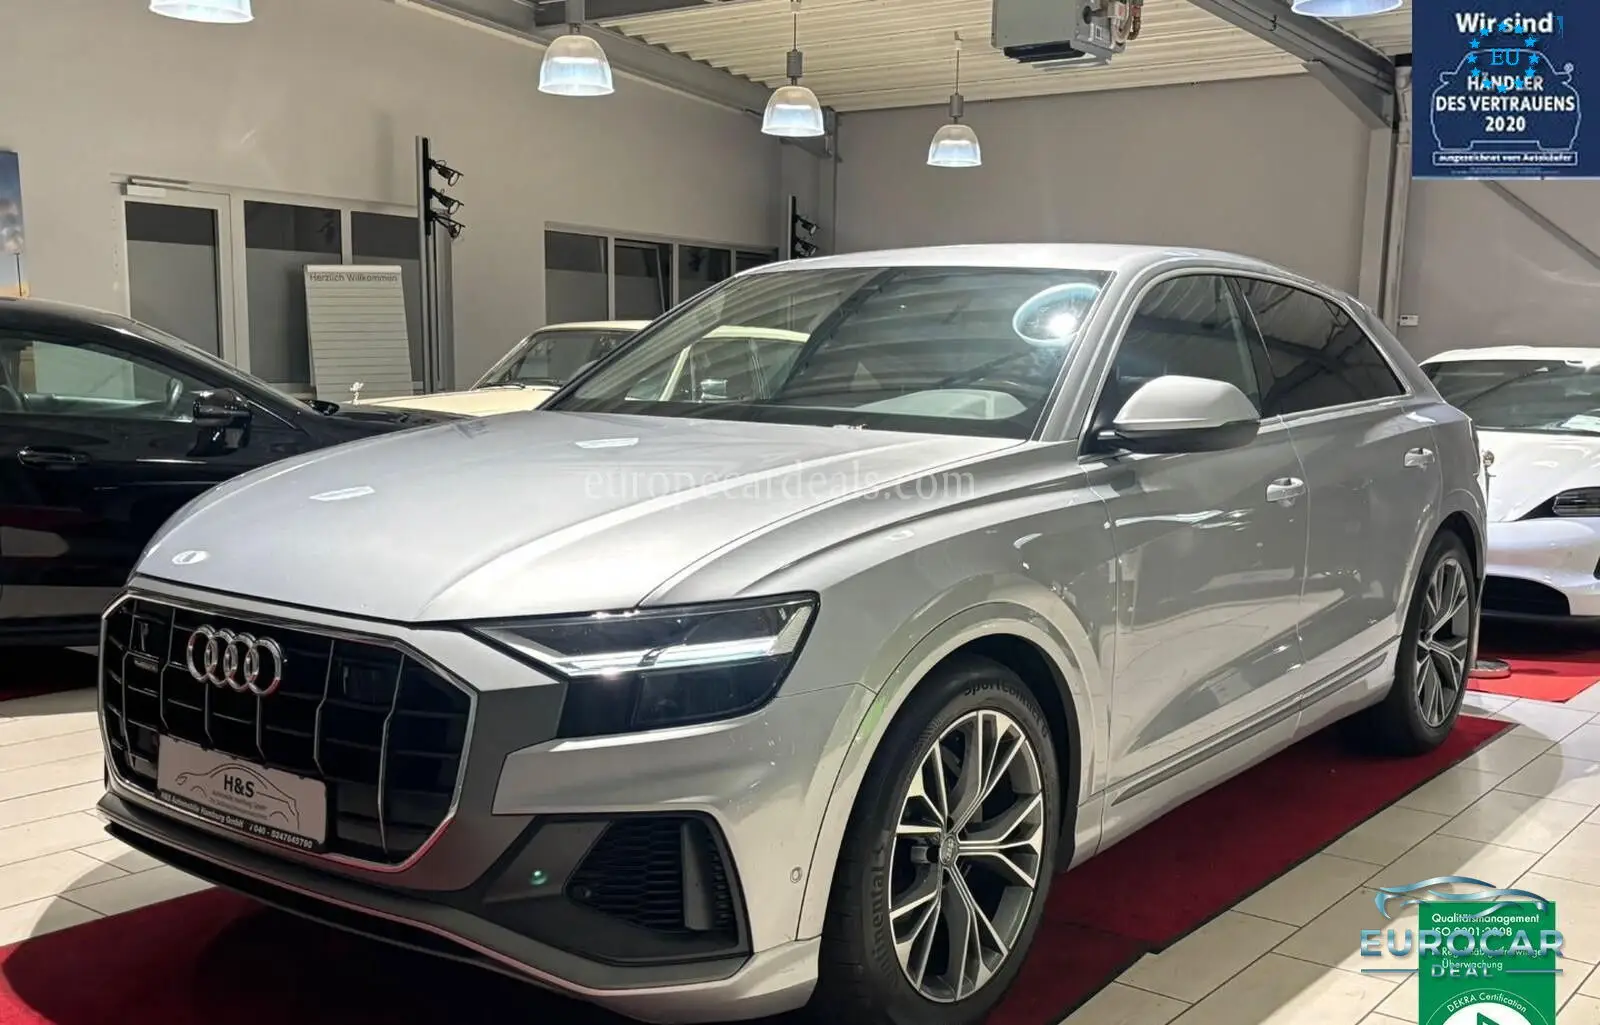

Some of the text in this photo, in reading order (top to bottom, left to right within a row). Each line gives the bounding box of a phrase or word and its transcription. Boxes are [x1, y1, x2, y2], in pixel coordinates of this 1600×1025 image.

[309, 272, 398, 282] Herzlich Willkommen
[223, 774, 255, 798] H&S
